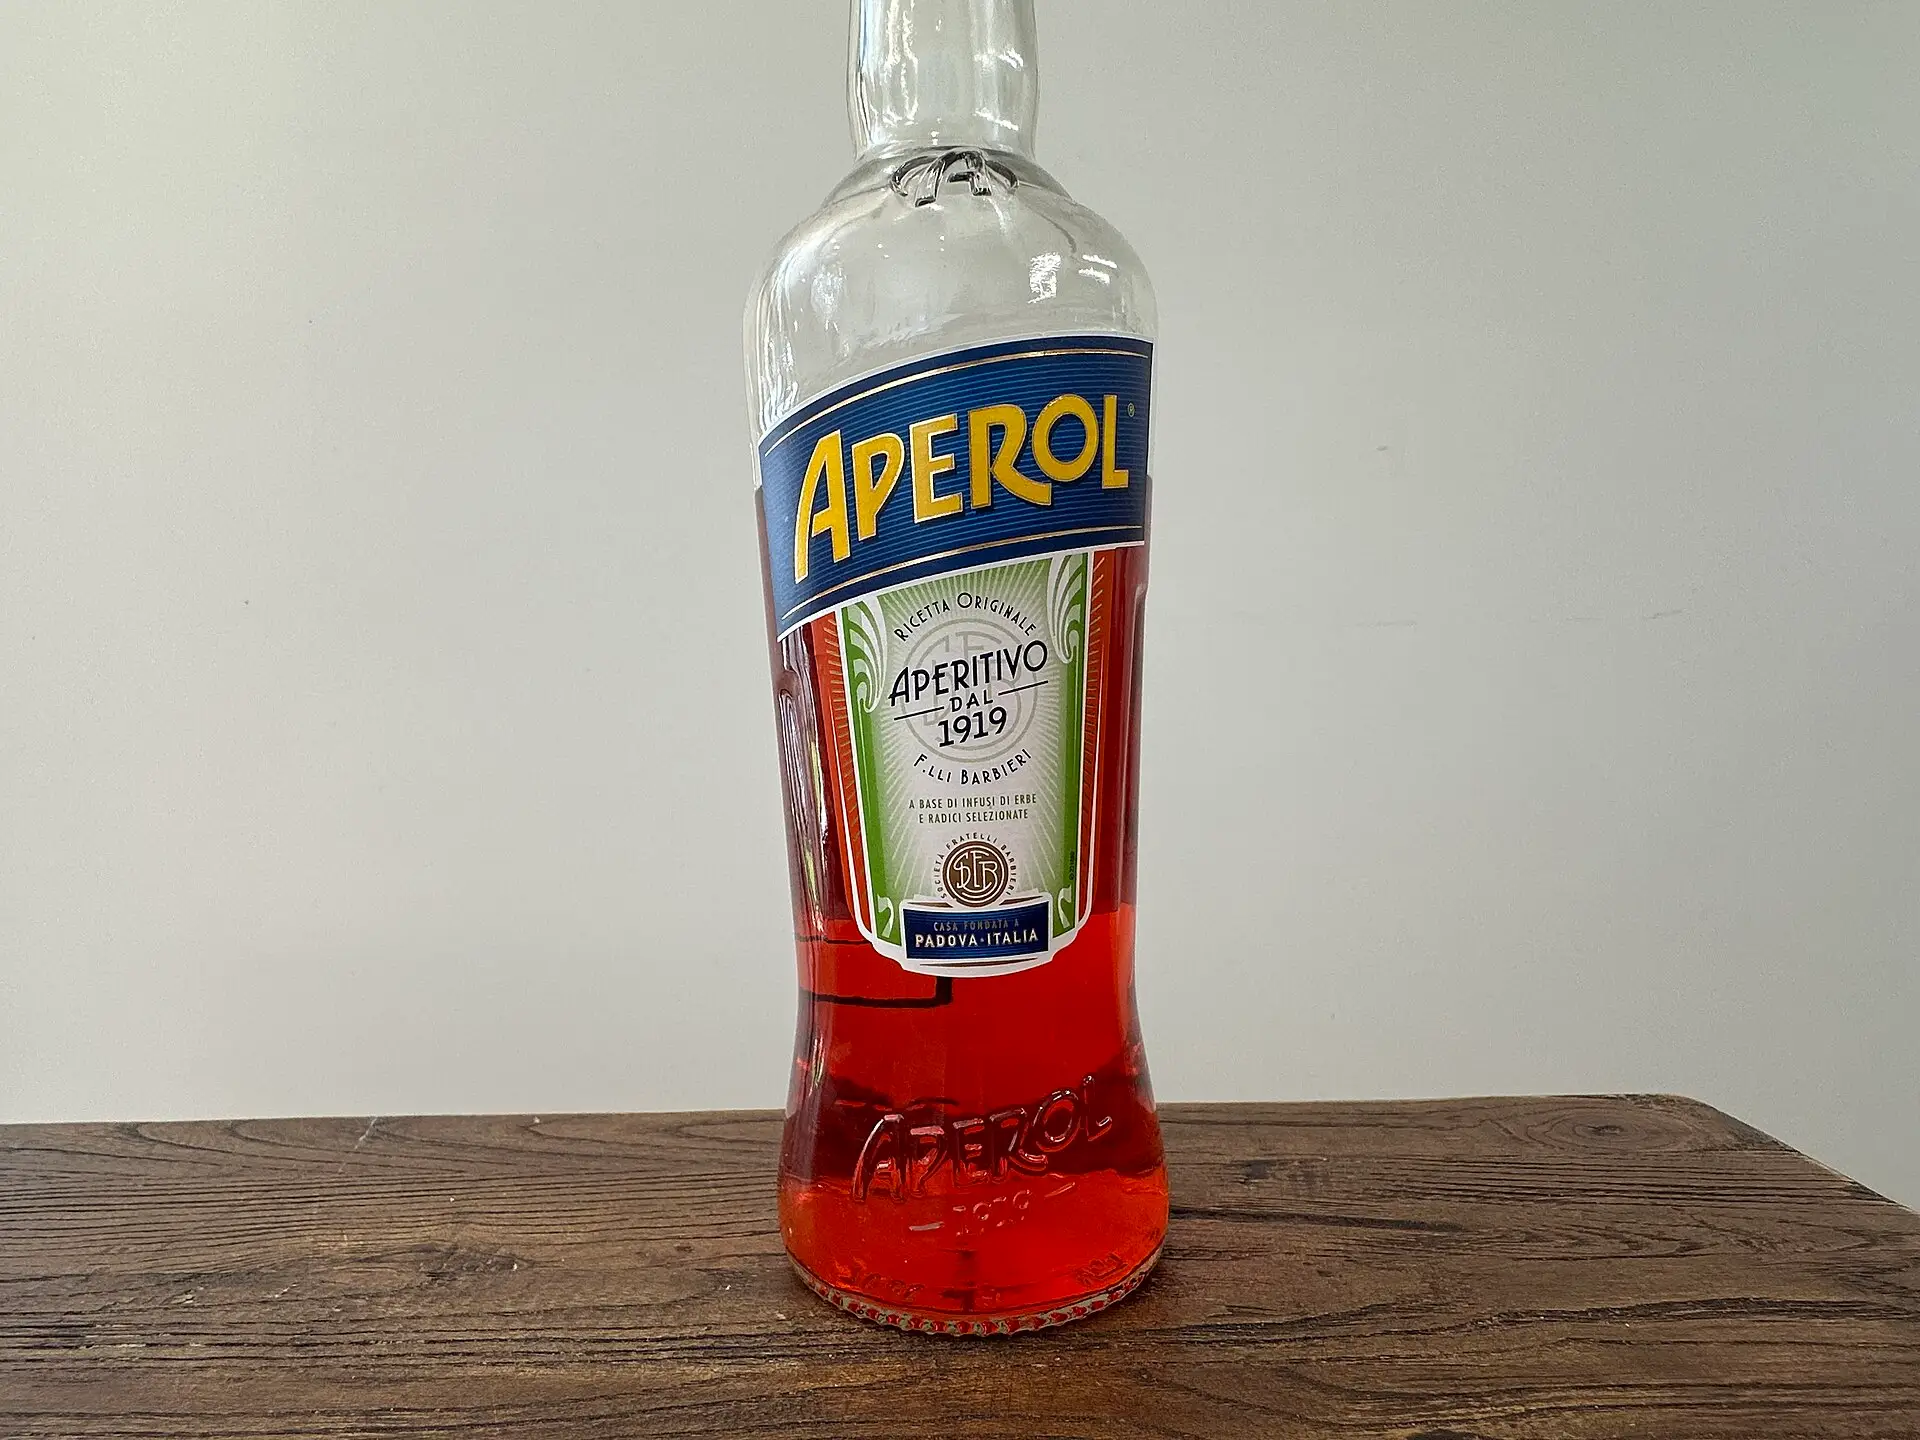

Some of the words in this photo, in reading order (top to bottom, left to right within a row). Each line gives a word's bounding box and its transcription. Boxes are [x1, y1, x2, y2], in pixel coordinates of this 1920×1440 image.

[794, 393, 1130, 585] APEROL
[894, 598, 951, 642] RICETTA
[957, 592, 1037, 637] ORIGINALE
[888, 640, 1048, 707] APERITIVO
[949, 689, 994, 713] DAL
[937, 706, 1008, 748] 1919
[913, 753, 952, 783] F.LLI
[960, 748, 1032, 785] BARBIERI
[908, 799, 916, 810] A
[919, 798, 943, 810] BASE
[947, 798, 958, 808] DI
[962, 796, 996, 808] INFUSI
[1000, 795, 1010, 806] DI
[1014, 793, 1037, 805] ERBE
[919, 813, 924, 824] E
[928, 812, 962, 825] RADICI
[965, 808, 1029, 823] SELEZIONATE
[945, 832, 998, 851] FRATELLI
[1000, 843, 1017, 896] BARBIERI
[915, 933, 979, 948] PADOVA
[986, 928, 1039, 947] ITALIA
[933, 921, 959, 932] CASA
[963, 919, 1009, 931] FONDATA
[1014, 918, 1020, 927] A
[850, 1075, 1113, 1201] APEROL
